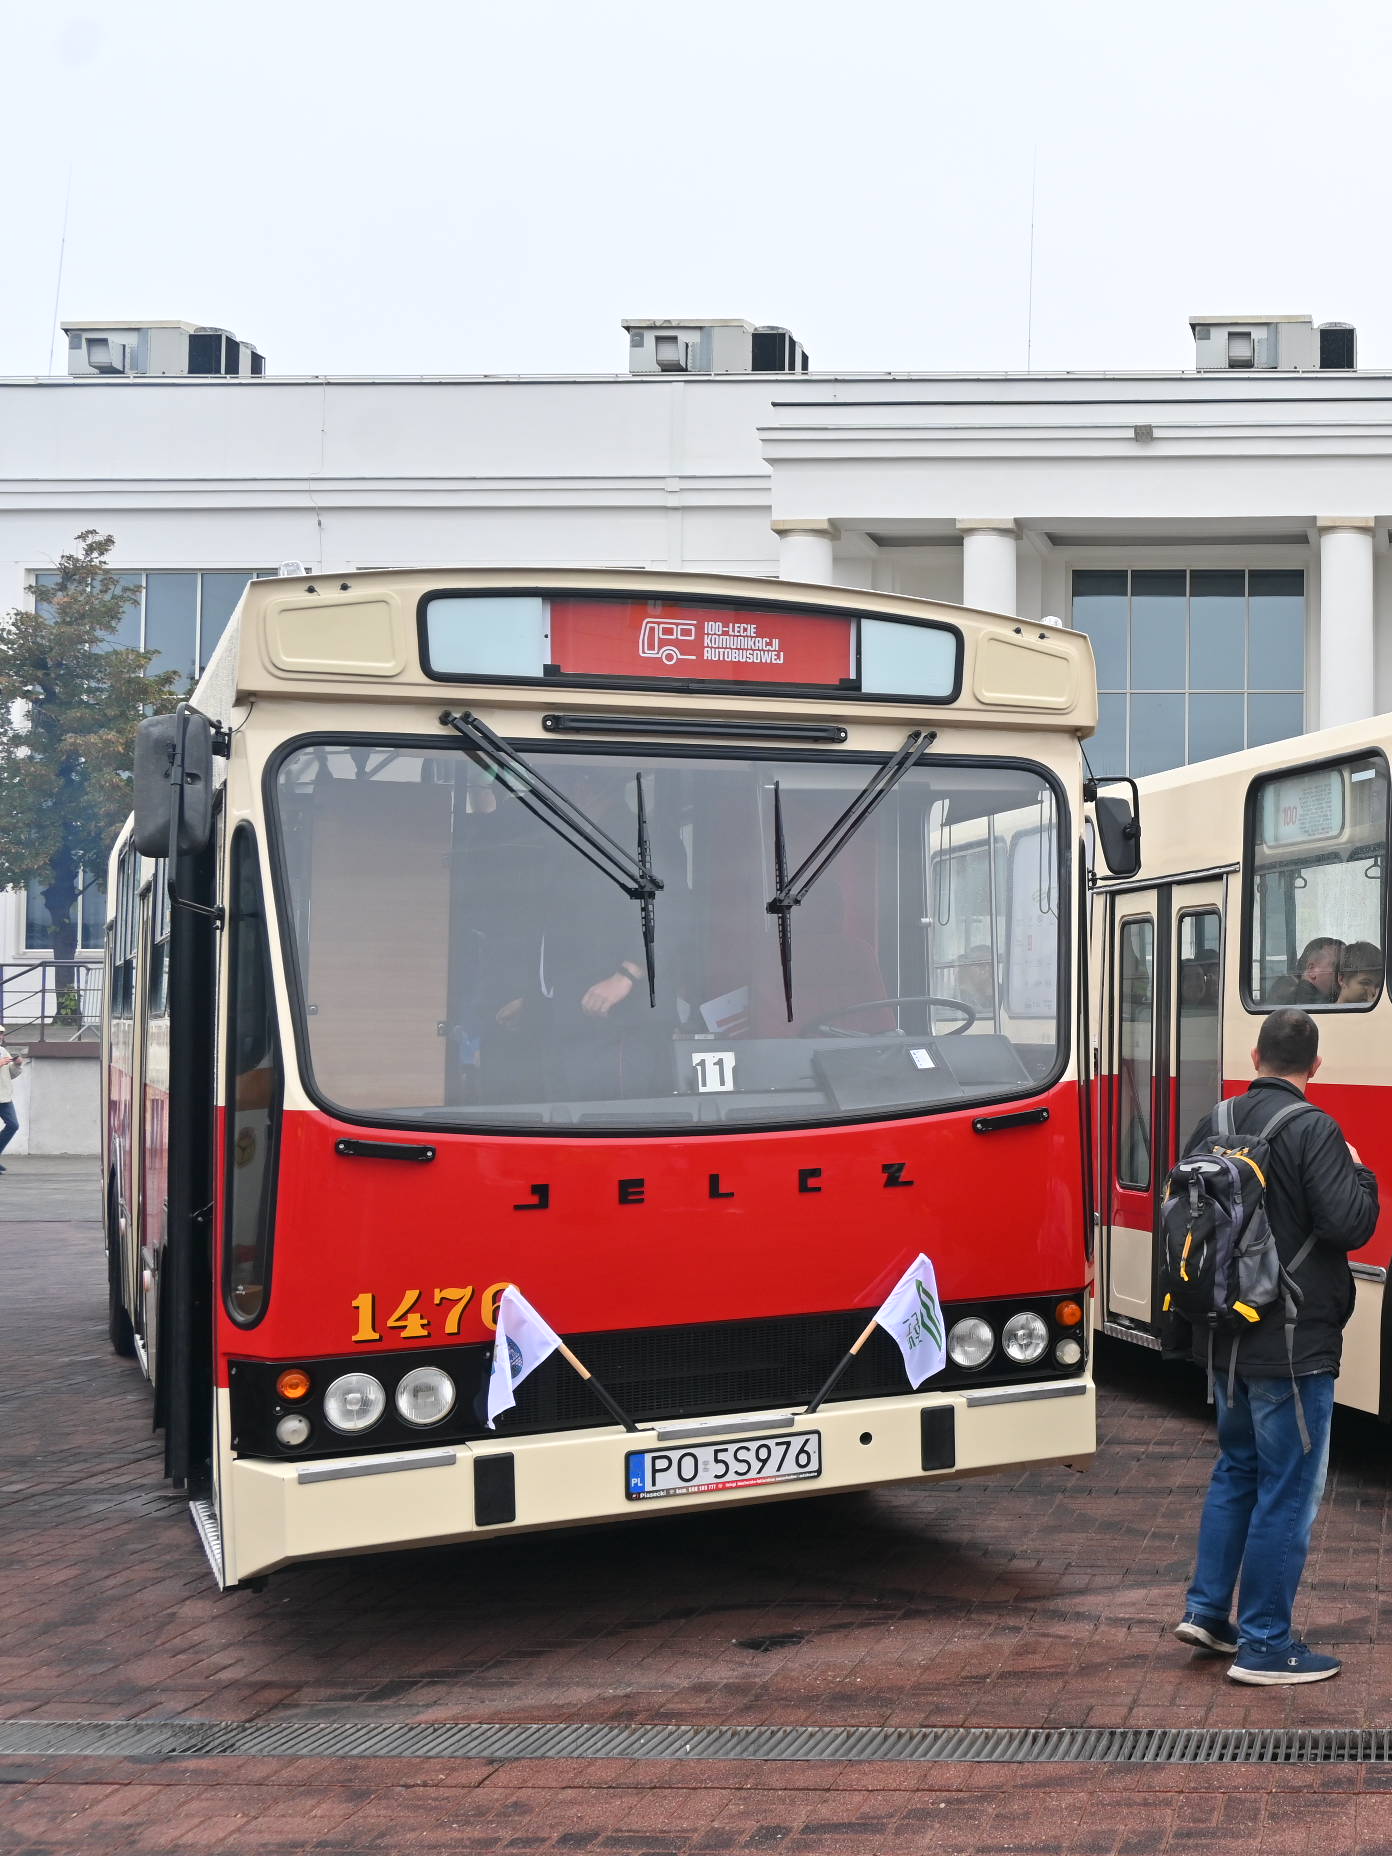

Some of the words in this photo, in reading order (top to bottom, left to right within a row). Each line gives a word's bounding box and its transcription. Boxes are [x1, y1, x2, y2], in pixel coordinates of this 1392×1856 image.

[704, 621, 757, 636] 100-LECIE
[703, 634, 779, 651] KOMUNIKACJI
[703, 648, 784, 664] AUTOBUSOWEJ
[695, 1057, 726, 1088] 11
[513, 1162, 915, 1211] JELCZ
[351, 1281, 521, 1343] 1476
[651, 1452, 699, 1487] PO
[713, 1438, 812, 1480] 5S976
[631, 1478, 643, 1488] PL
